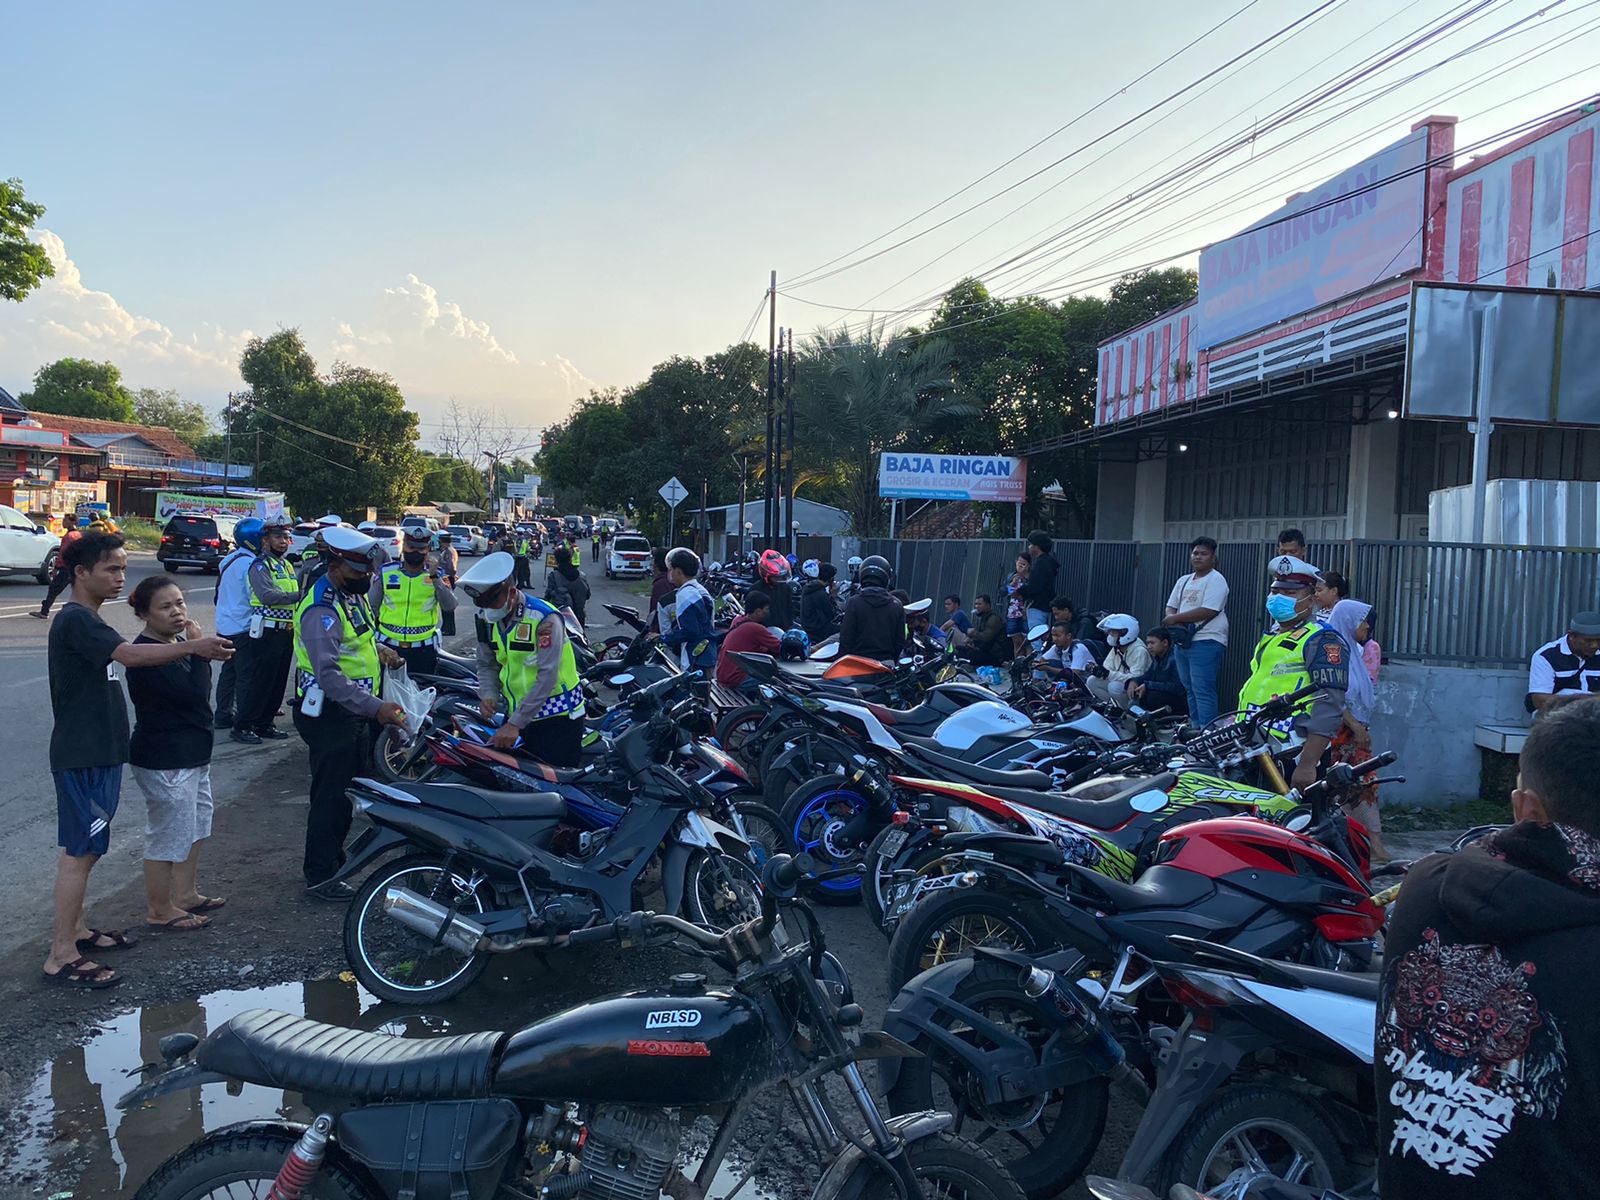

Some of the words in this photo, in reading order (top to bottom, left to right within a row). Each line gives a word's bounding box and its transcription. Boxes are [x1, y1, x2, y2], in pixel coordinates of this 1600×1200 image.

[886, 457, 935, 473] BAJA
[940, 459, 1010, 476] RINGAN
[886, 476, 922, 488] GROSIR
[932, 477, 970, 489] ECERAN
[999, 481, 1023, 489] TRUSS
[998, 713, 1017, 724] Ninja
[1187, 727, 1247, 754] RENTHAL
[1194, 787, 1275, 802] CRF
[650, 1011, 698, 1025] NBLSD
[1389, 1080, 1511, 1158] CULTURE
[1389, 1119, 1486, 1178] PRIDE
